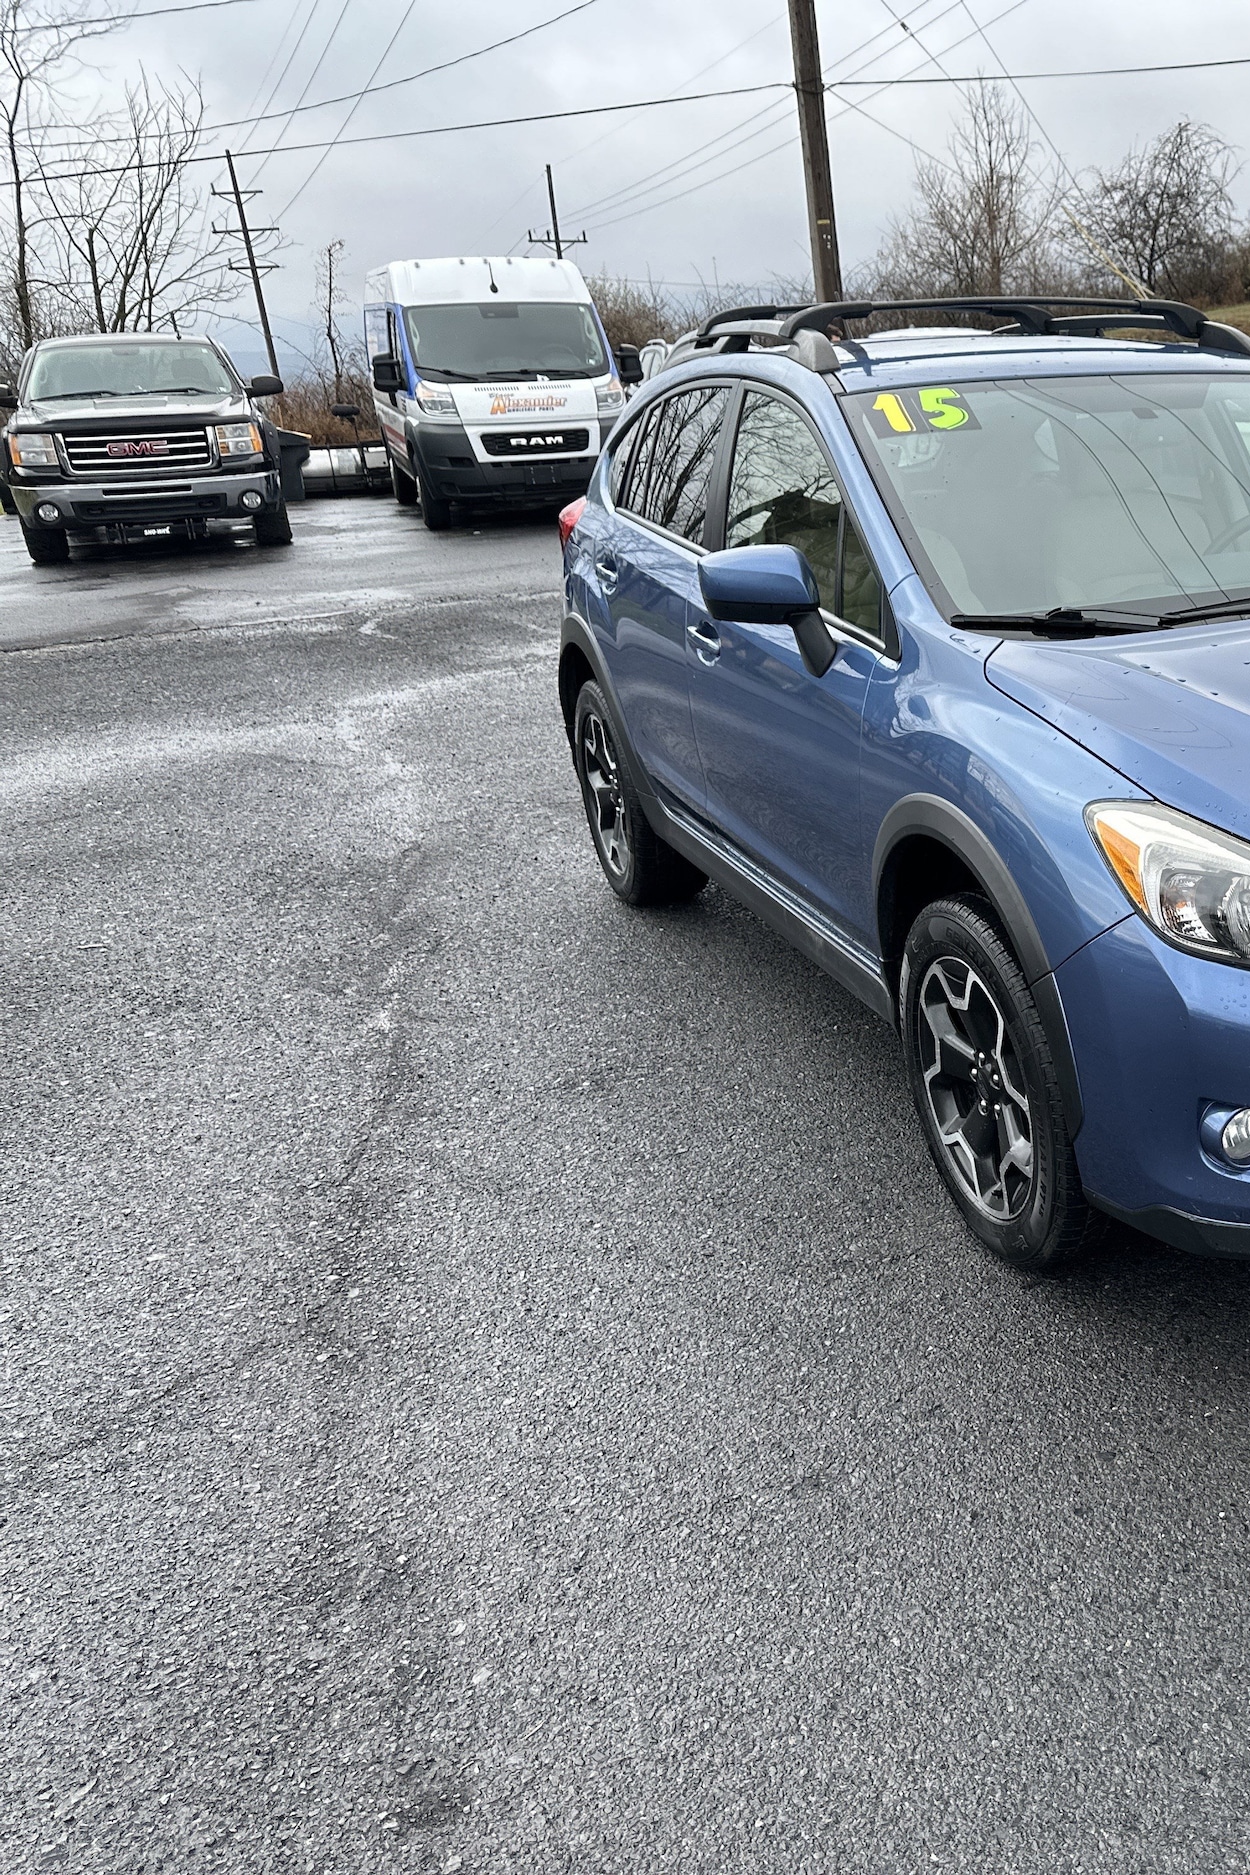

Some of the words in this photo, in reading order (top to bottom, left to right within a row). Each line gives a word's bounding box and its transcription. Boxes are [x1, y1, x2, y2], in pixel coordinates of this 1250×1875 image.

[872, 387, 969, 432] 15
[106, 440, 169, 456] GMC
[509, 436, 563, 446] RAM
